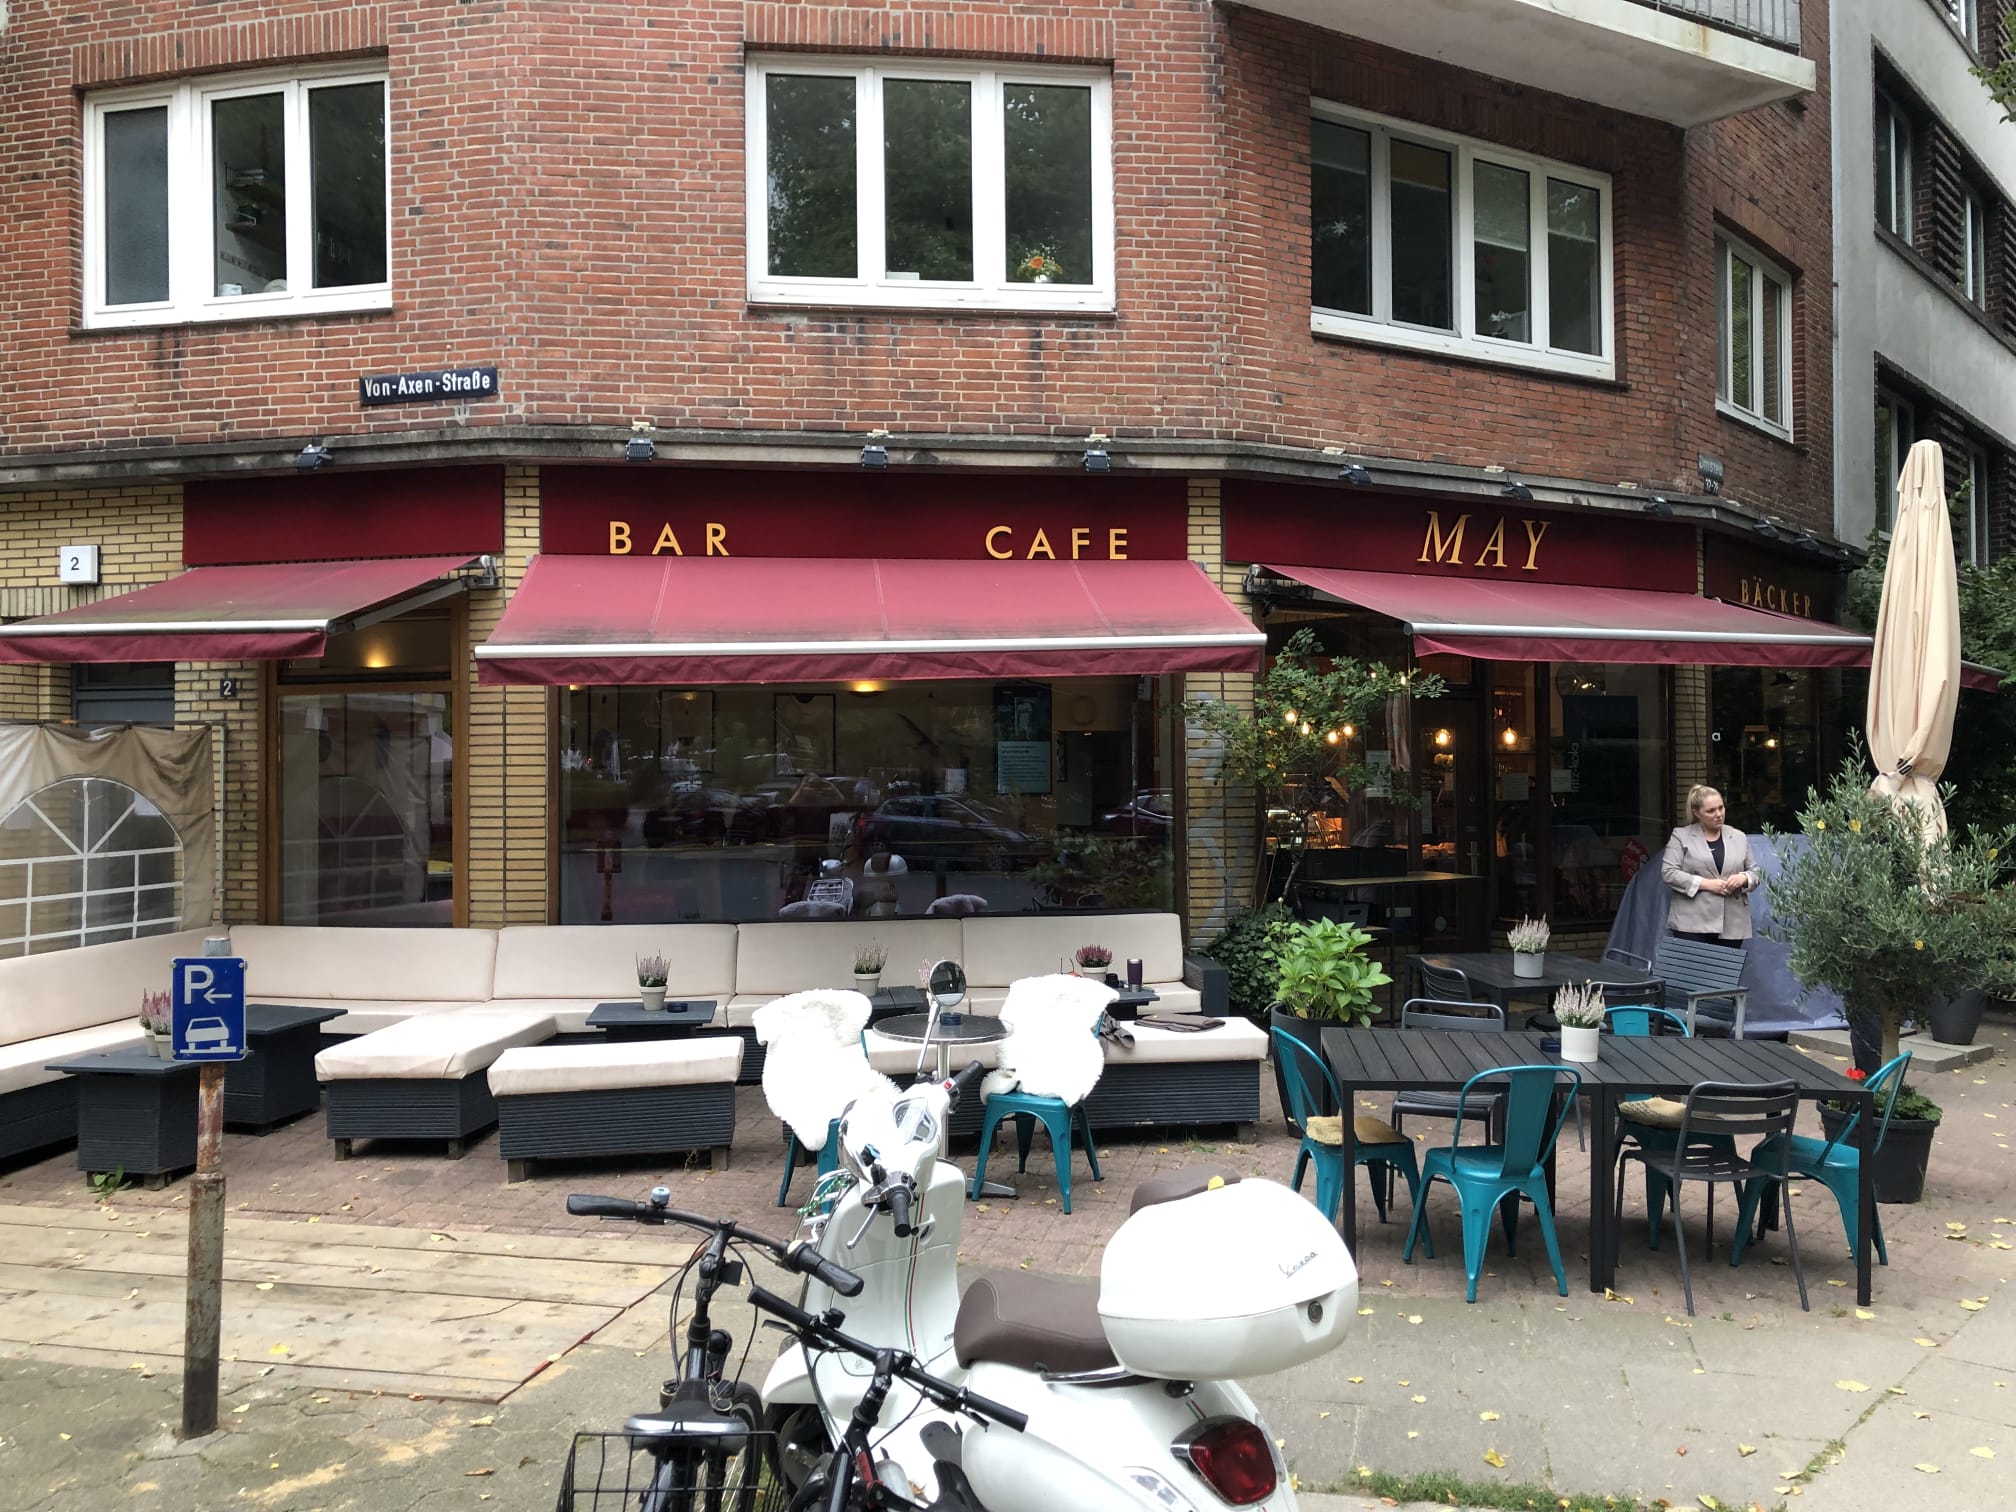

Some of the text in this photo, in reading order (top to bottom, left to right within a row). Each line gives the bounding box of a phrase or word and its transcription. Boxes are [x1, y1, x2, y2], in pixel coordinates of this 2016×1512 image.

[364, 370, 491, 398] Von-Axen-Straße
[609, 520, 1129, 560] BAR CAFE
[1416, 510, 1552, 570] MAY
[70, 556, 80, 571] 2
[1741, 576, 1811, 617] BÄCKER
[223, 680, 232, 696] 2
[184, 965, 215, 1005] P
